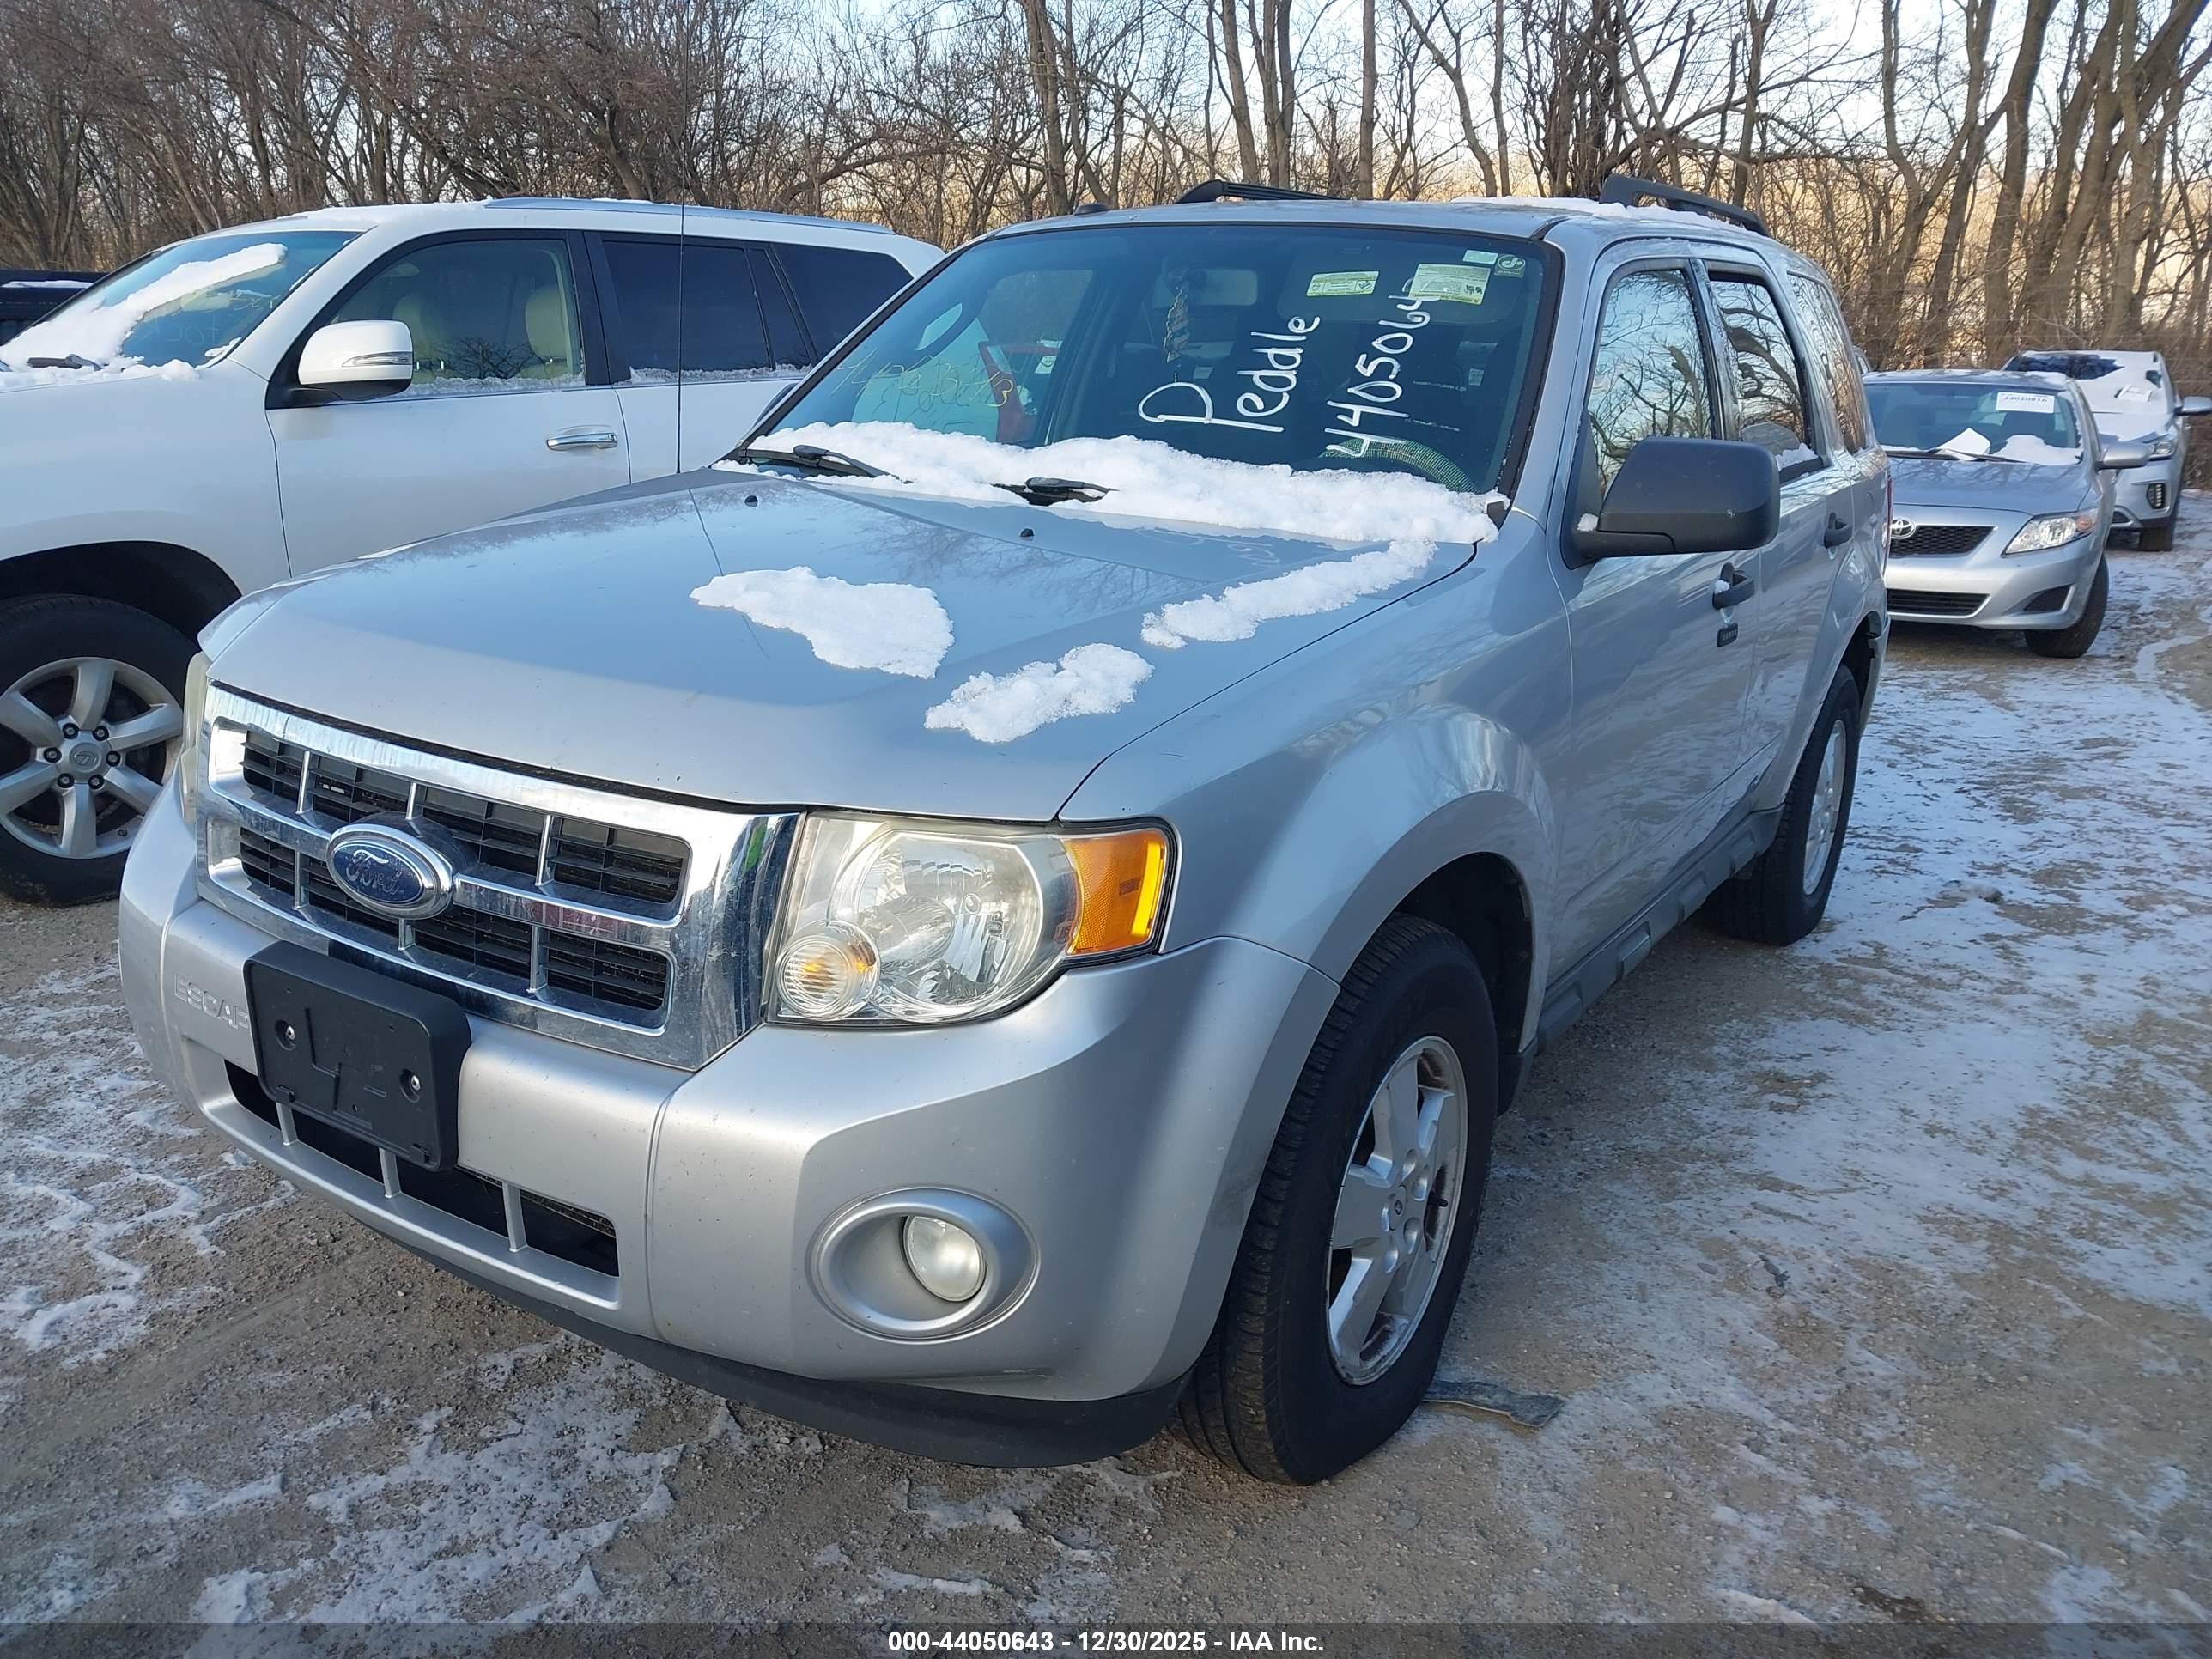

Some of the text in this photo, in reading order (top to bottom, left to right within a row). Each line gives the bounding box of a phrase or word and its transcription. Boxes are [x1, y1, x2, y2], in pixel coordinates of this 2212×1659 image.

[1139, 317, 1321, 432] Peddle
[346, 849, 404, 895] Ford
[174, 975, 249, 1030] ESCAP
